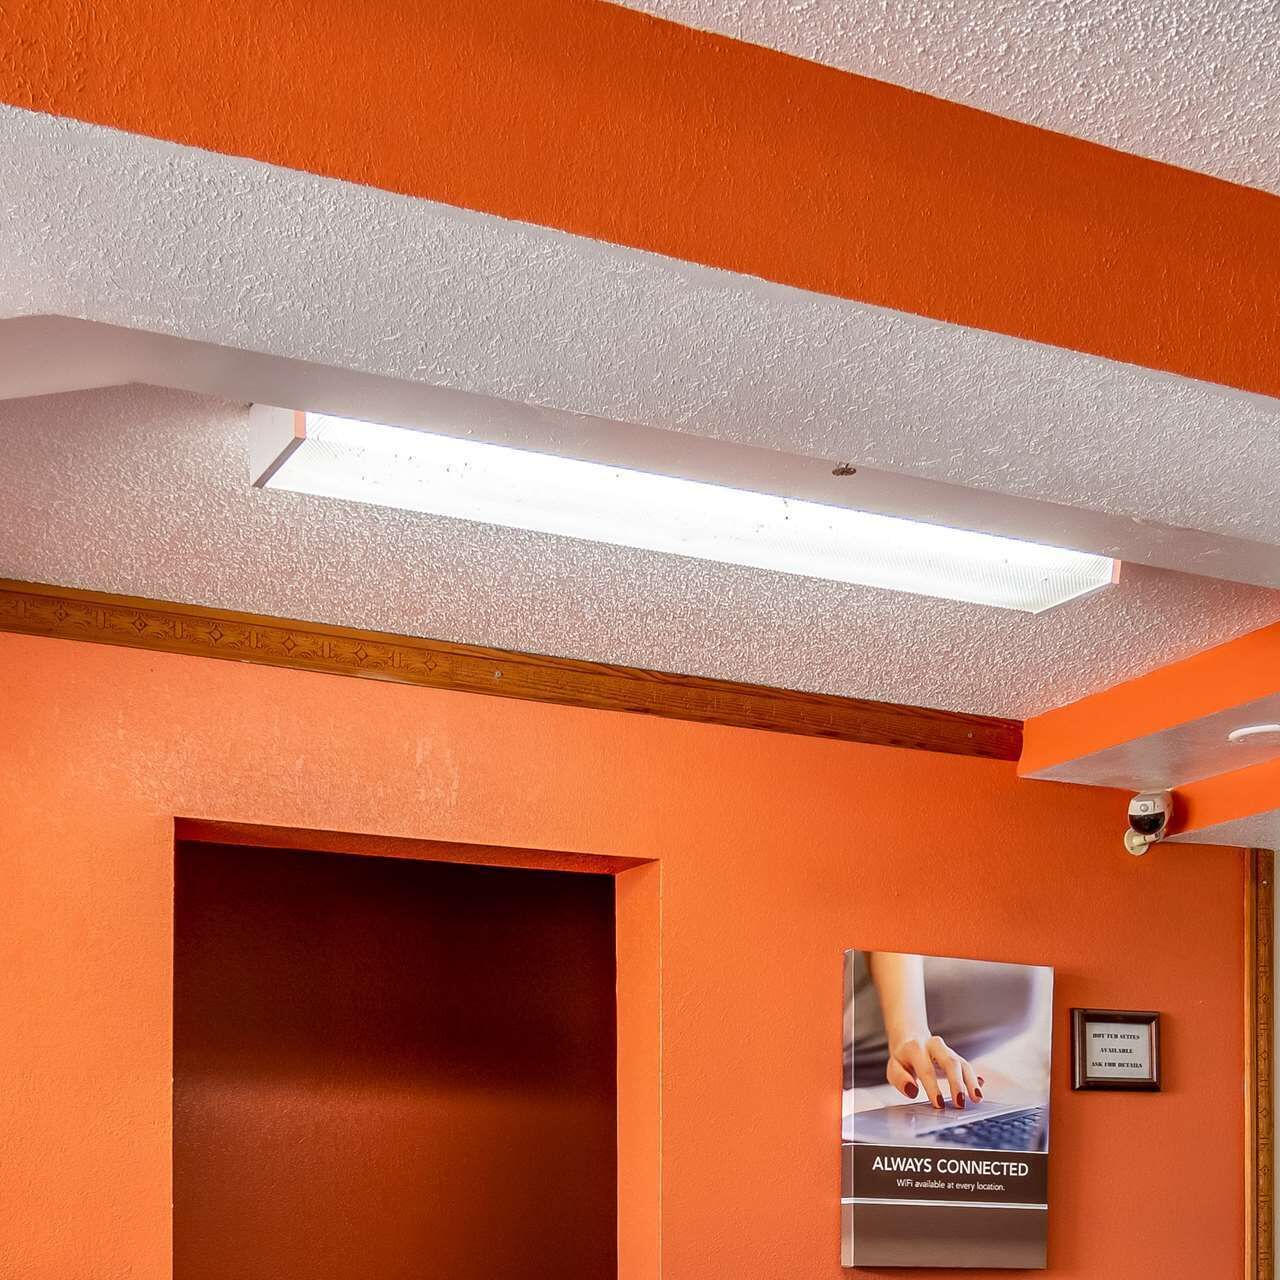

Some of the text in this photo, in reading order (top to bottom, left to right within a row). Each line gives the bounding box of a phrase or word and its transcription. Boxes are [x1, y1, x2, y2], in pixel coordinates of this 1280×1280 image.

[872, 1156, 1029, 1177] ALWAYS CONNECTED
[896, 1178, 1006, 1192] WiFi available at every location.
